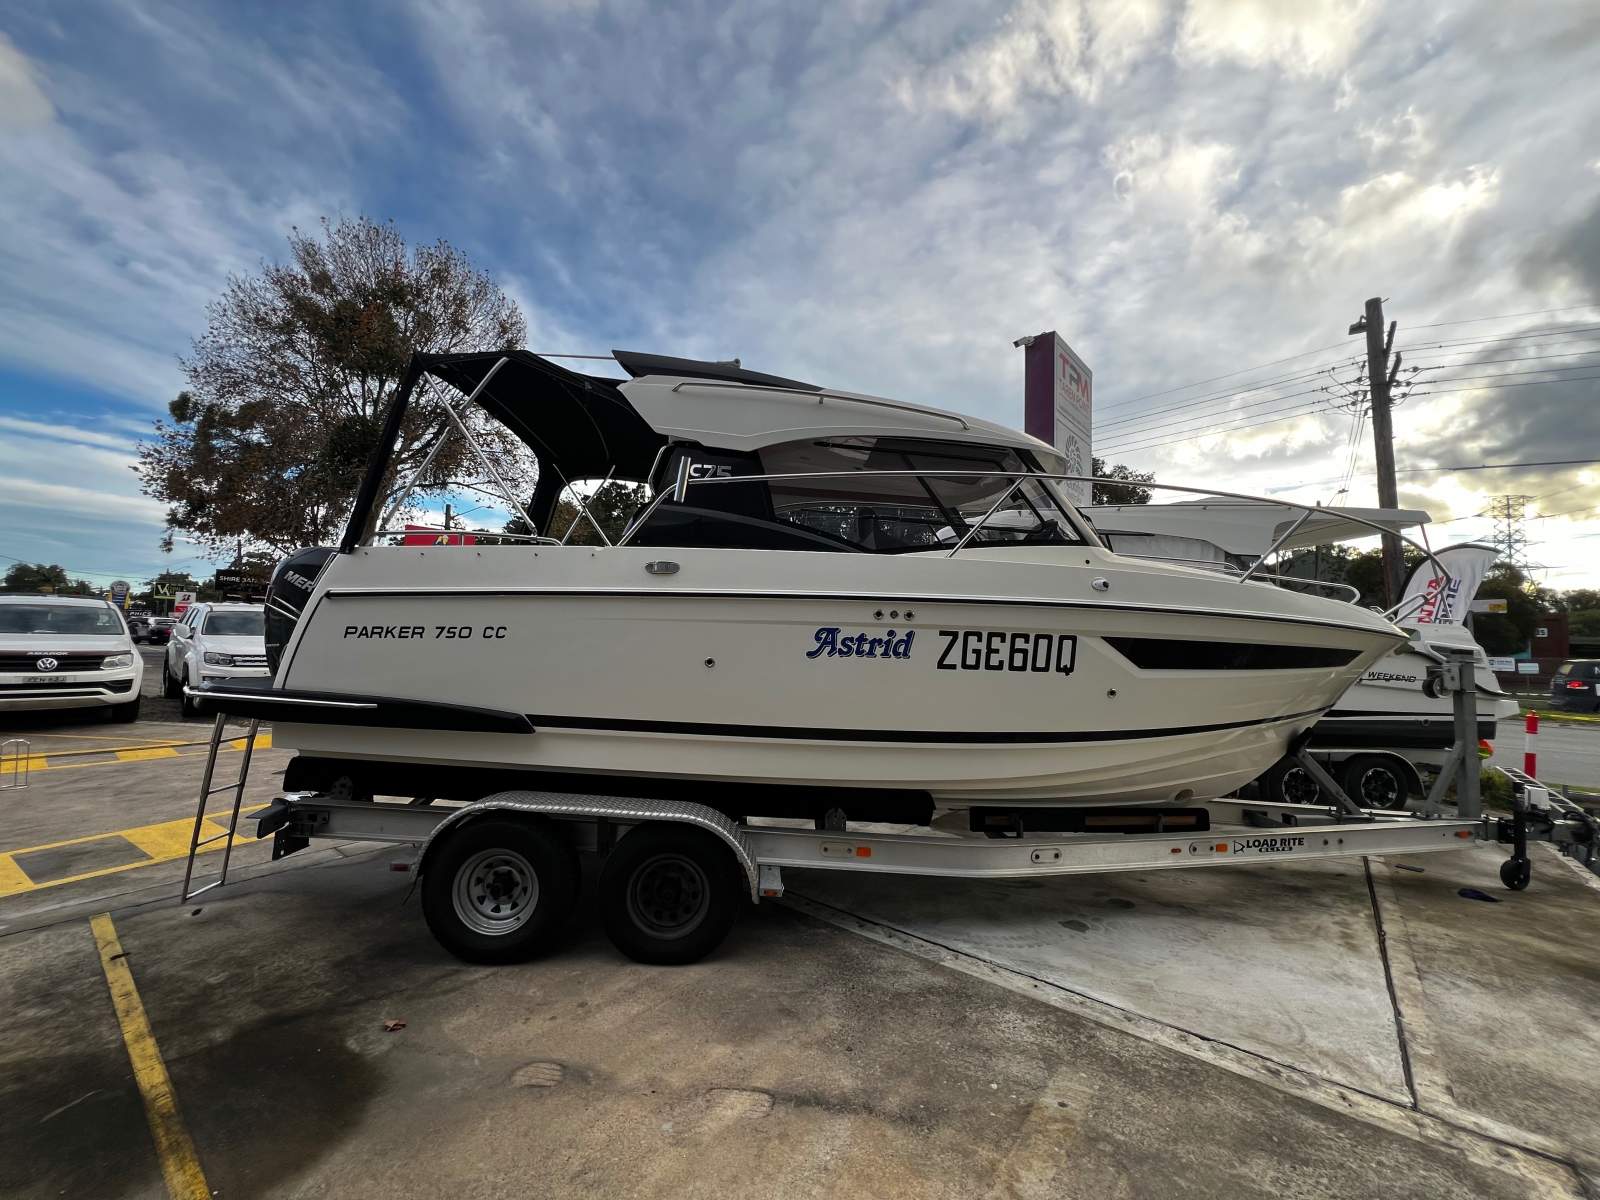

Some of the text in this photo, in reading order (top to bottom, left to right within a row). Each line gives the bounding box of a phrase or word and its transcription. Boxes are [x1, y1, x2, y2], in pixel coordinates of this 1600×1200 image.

[690, 464, 731, 479] C75
[344, 626, 507, 639] PARKER 750 CC
[806, 627, 1078, 676] Astrid ZGE60Q
[1368, 671, 1416, 683] WEEKEND
[1246, 837, 1304, 848] LOAD RITE
